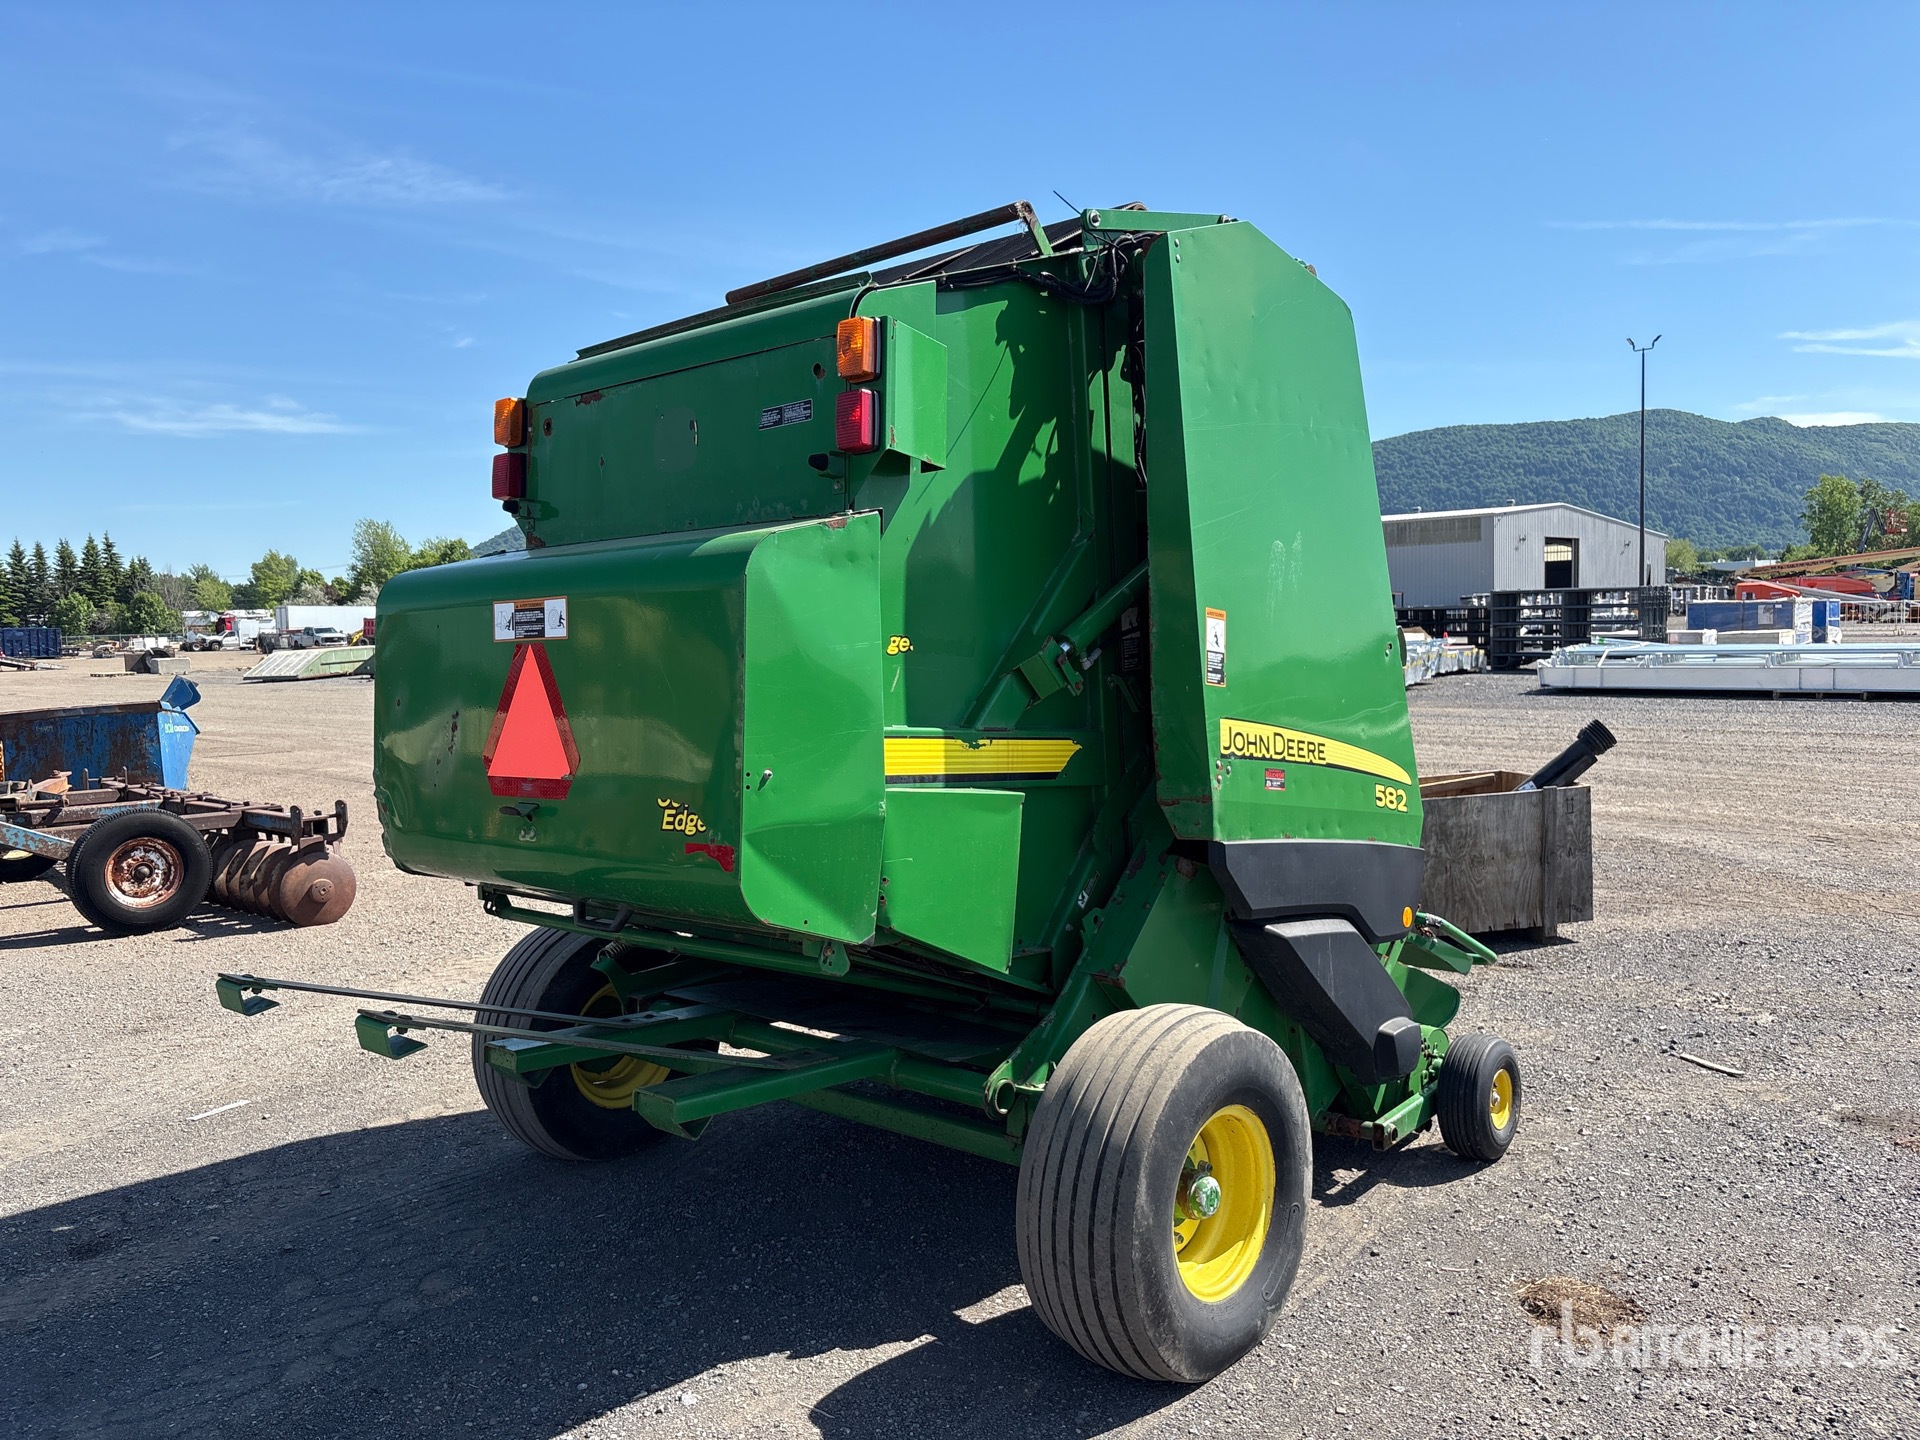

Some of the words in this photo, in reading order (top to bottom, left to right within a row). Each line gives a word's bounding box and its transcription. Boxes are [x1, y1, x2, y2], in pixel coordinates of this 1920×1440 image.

[1222, 726, 1270, 755] JOHN
[1273, 732, 1327, 761] DEERE
[1375, 783, 1408, 813] 582
